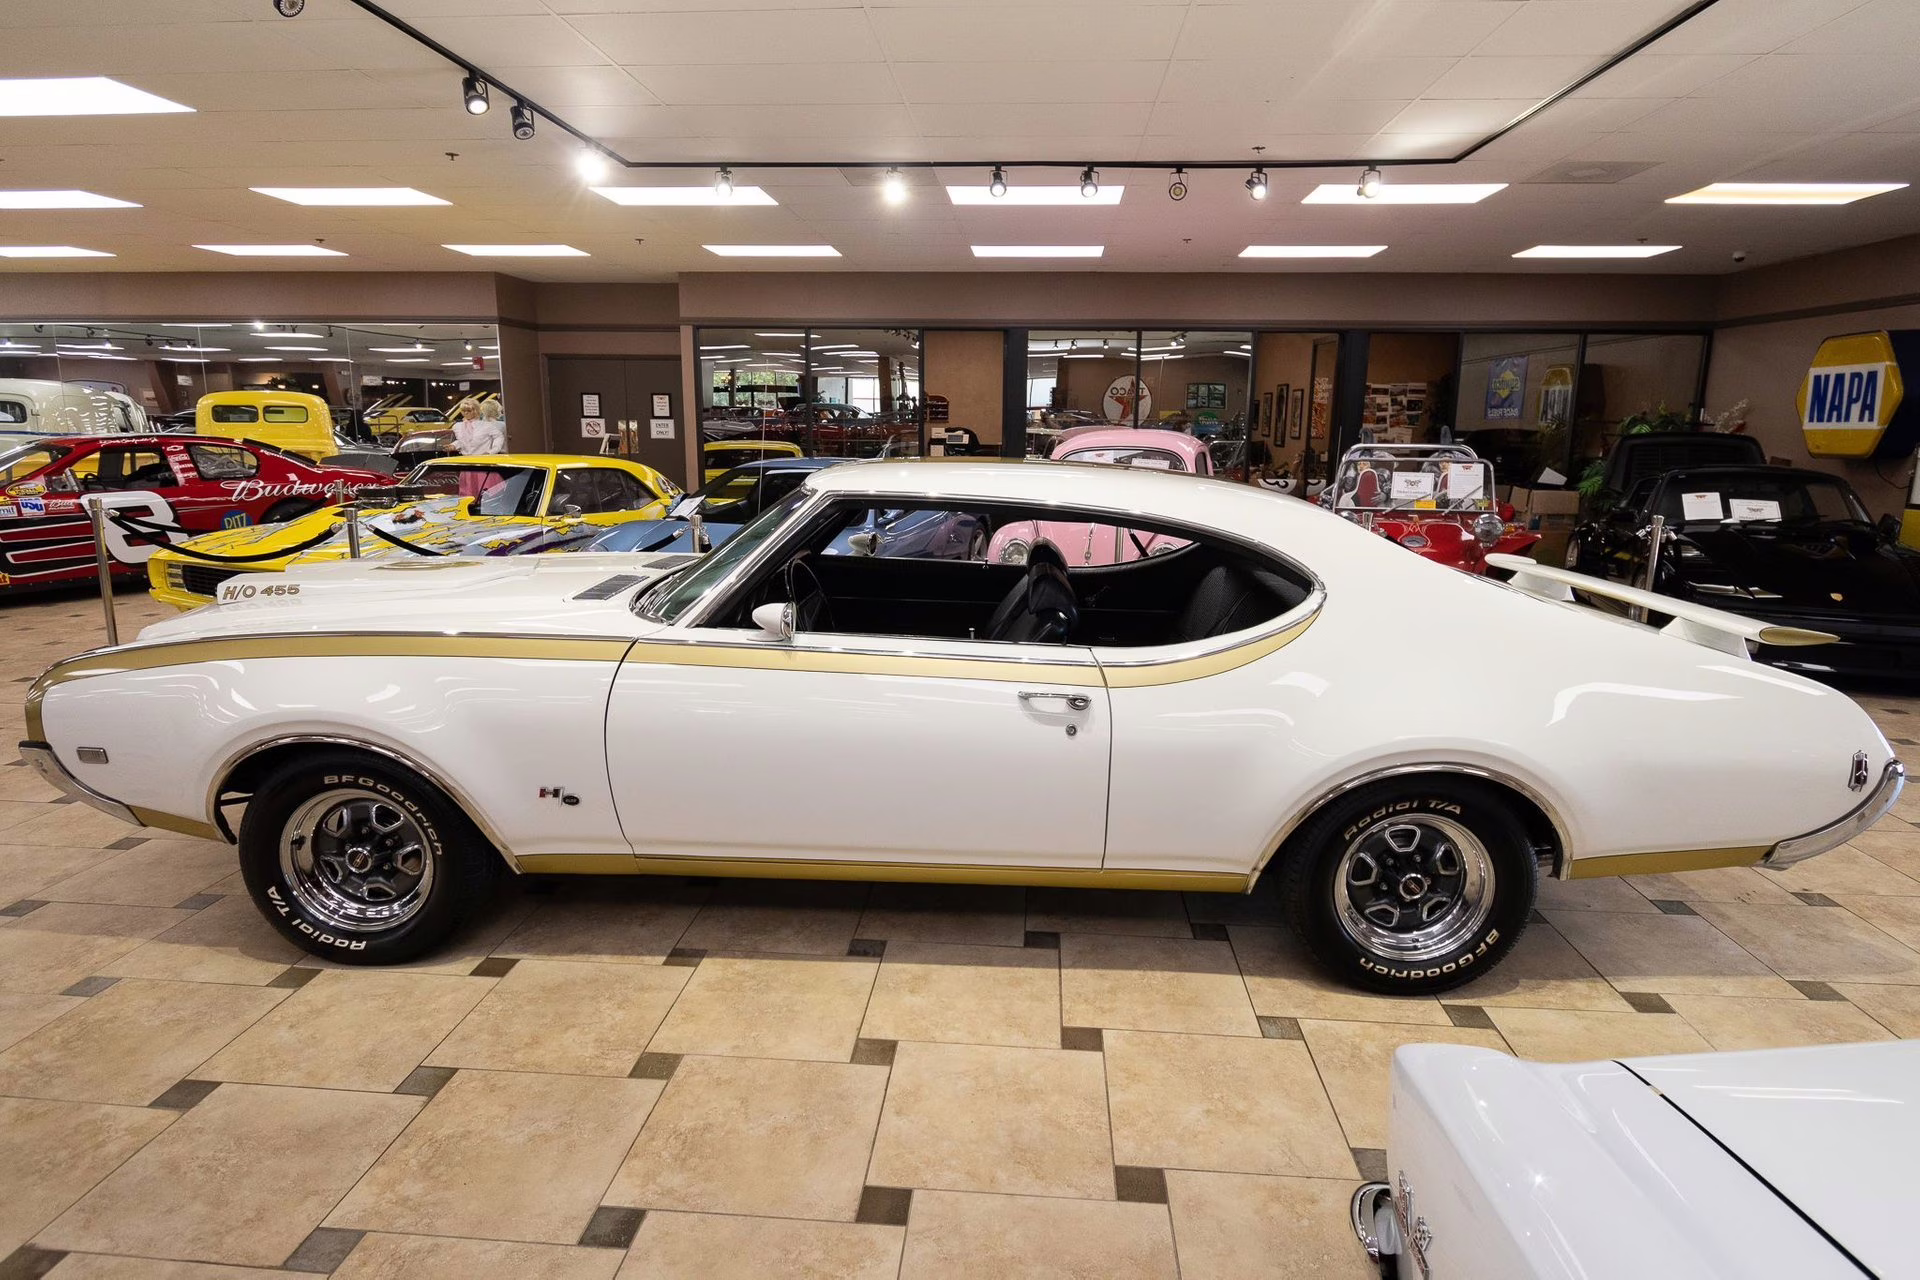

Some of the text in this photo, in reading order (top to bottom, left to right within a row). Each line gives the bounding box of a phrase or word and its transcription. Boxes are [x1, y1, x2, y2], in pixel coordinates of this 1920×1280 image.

[1807, 370, 1879, 423] NAPA
[222, 584, 300, 600] H/O 455
[323, 774, 443, 856] BFGoodrich
[1343, 800, 1461, 840] Radial T/A
[266, 885, 367, 951] Radial T/A
[1359, 928, 1500, 980] BFGoodrich
